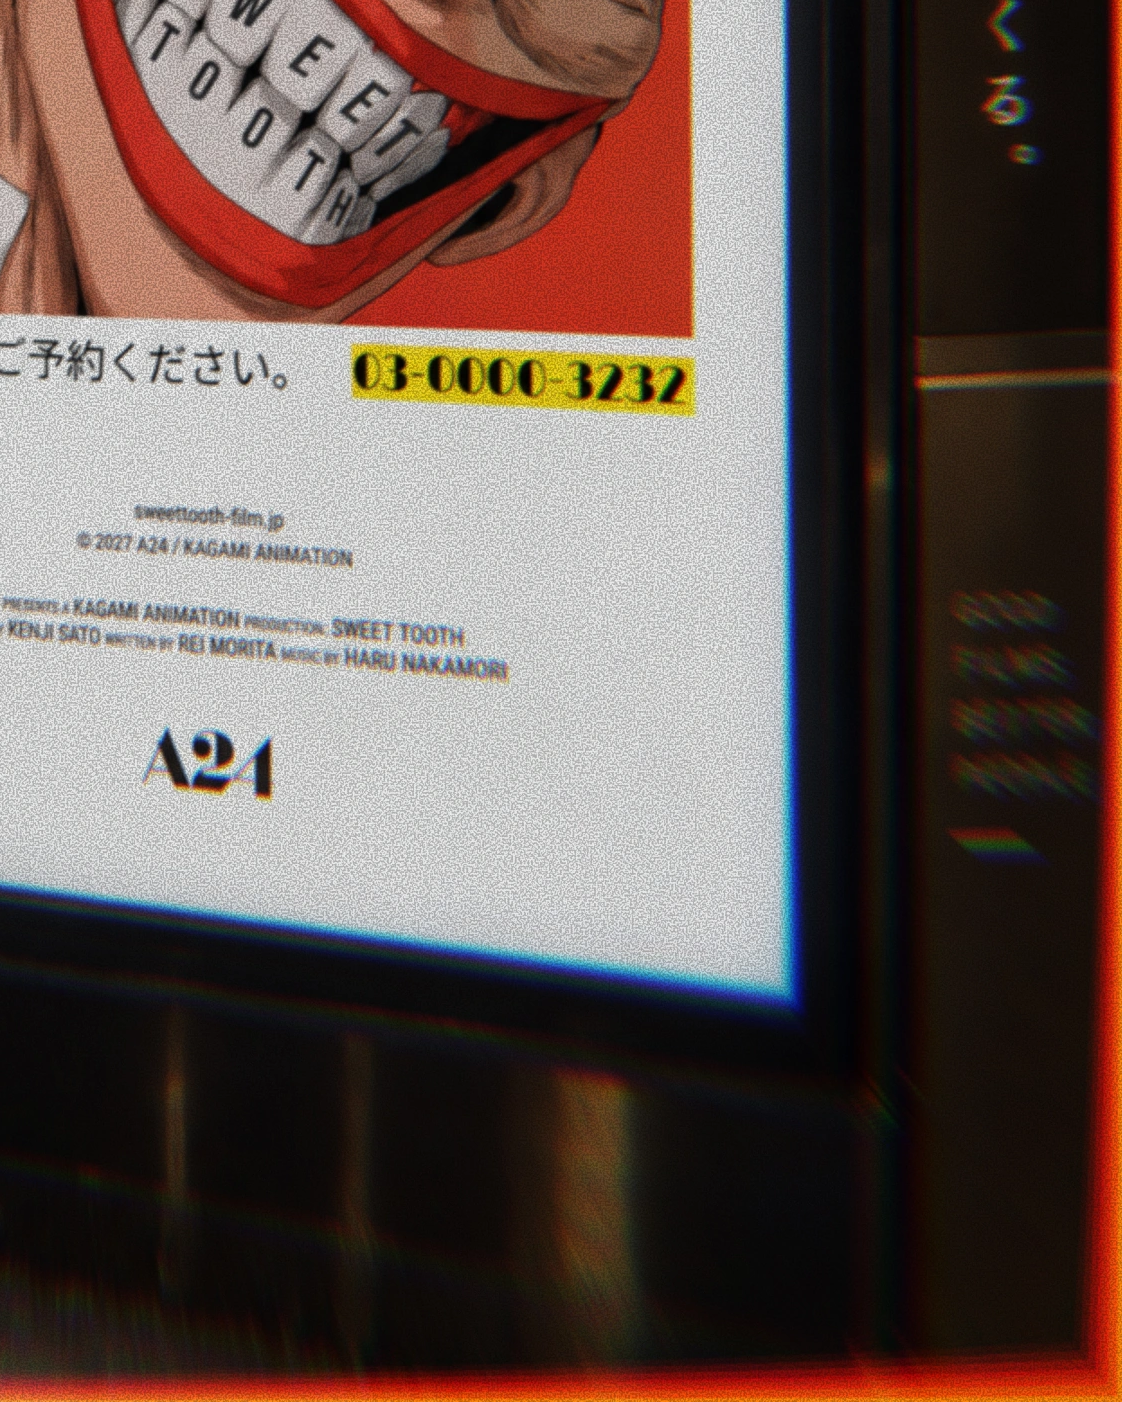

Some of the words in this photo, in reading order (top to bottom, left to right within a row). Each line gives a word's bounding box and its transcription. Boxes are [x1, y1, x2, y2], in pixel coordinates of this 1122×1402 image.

[150, 17, 356, 232] TOOTH
[353, 350, 691, 406] 03-0000-3232
[134, 504, 285, 533] sweettooth-film.jp
[95, 533, 133, 551] 2027
[137, 536, 169, 555] A24
[183, 538, 251, 561] KAGAMI
[254, 544, 354, 568] ANIMATION
[8, 619, 54, 641] KENJI
[58, 623, 101, 646] SATO
[178, 633, 205, 654] REI
[209, 635, 277, 661] MORITA
[344, 648, 397, 672] HARU
[401, 653, 509, 682] NAKAMORI
[73, 599, 139, 621] KAGAMI
[143, 604, 240, 629] ANIMATION
[332, 618, 394, 642] SWEET
[400, 623, 466, 648] TOOTH
[143, 726, 272, 800] A24
